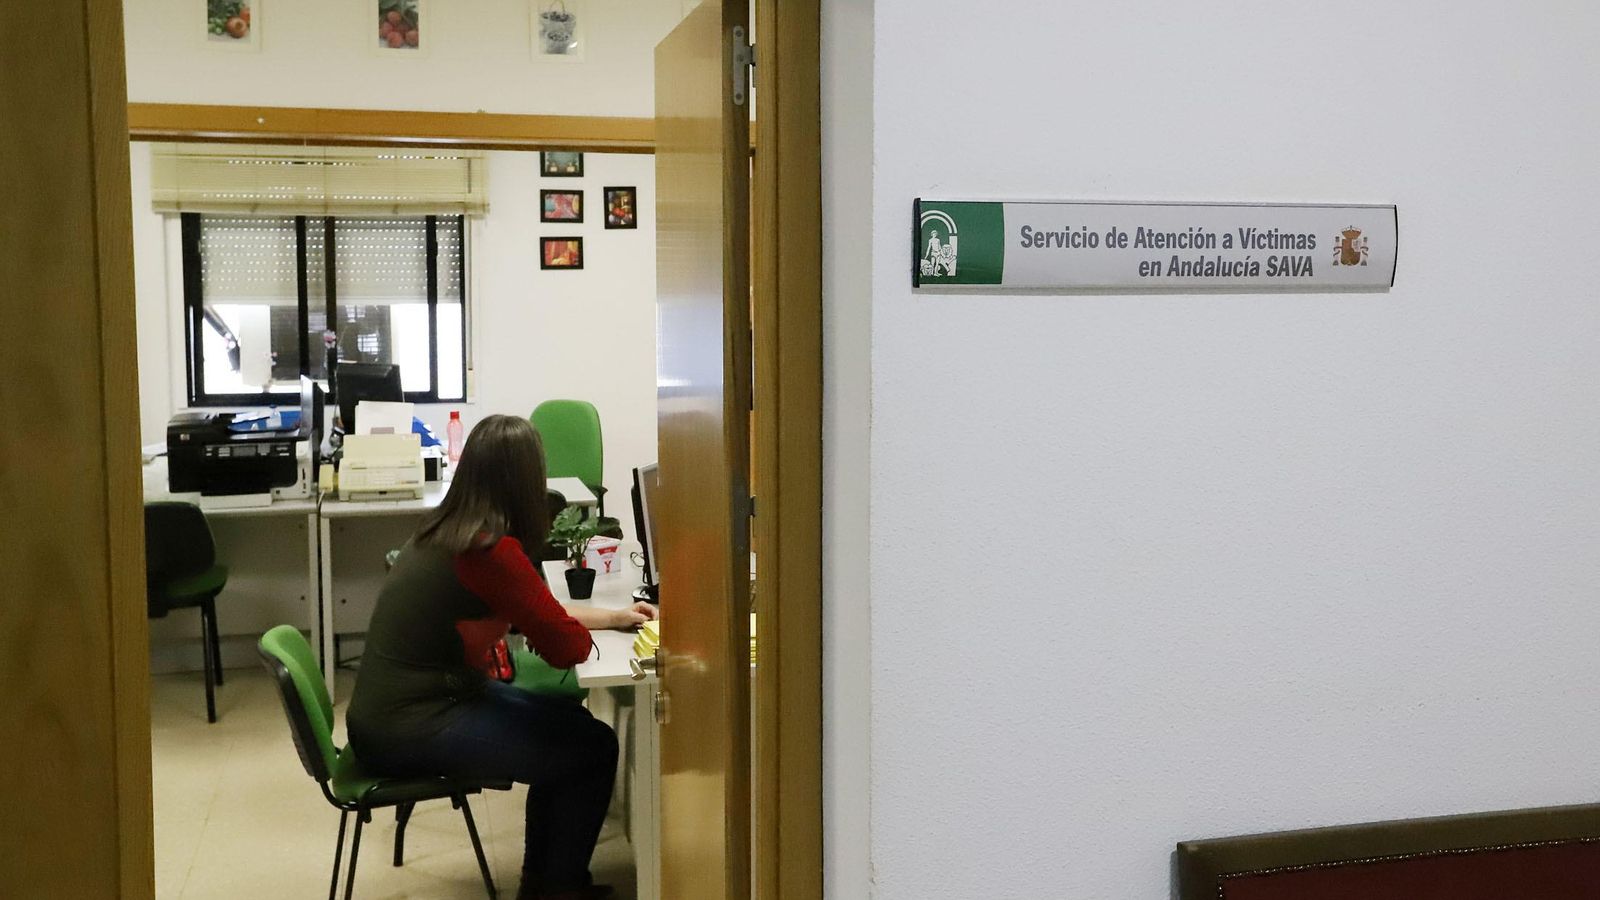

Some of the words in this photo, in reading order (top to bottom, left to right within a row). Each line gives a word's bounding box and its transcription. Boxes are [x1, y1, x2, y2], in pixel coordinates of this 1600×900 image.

[1020, 224, 1100, 250] Servicio
[1104, 225, 1129, 249] de
[1134, 226, 1217, 250] Atención
[1221, 232, 1234, 250] a
[1238, 227, 1317, 251] Víctimas
[1138, 260, 1162, 278] en
[1165, 254, 1261, 278] Andalucía
[1265, 254, 1314, 278] SAVA
